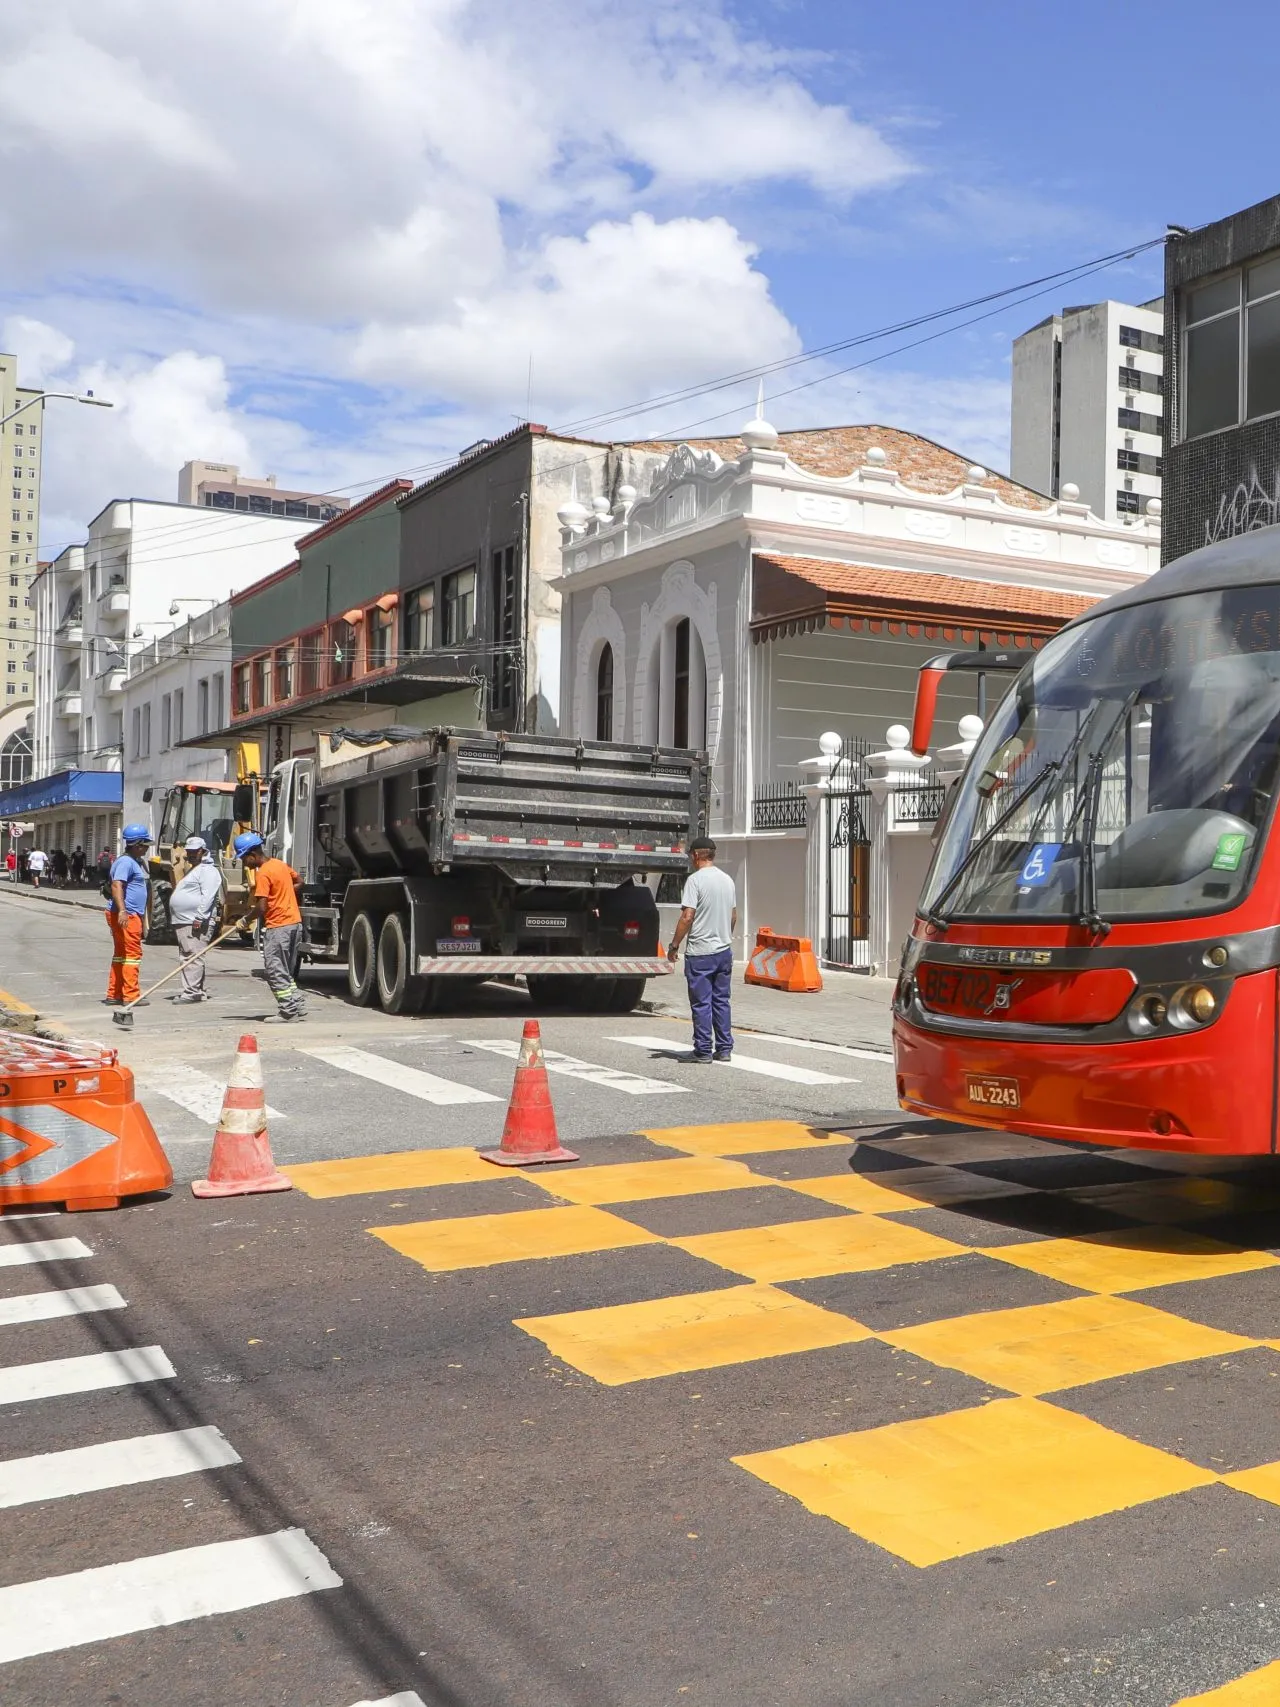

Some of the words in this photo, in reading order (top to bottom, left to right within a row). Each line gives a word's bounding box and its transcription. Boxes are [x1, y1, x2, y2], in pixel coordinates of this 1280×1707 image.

[458, 750, 499, 759] RODOGREEN
[651, 766, 688, 775] RODOGREEN
[527, 919, 566, 927] RODOGREEN
[925, 968, 990, 1009] BE702
